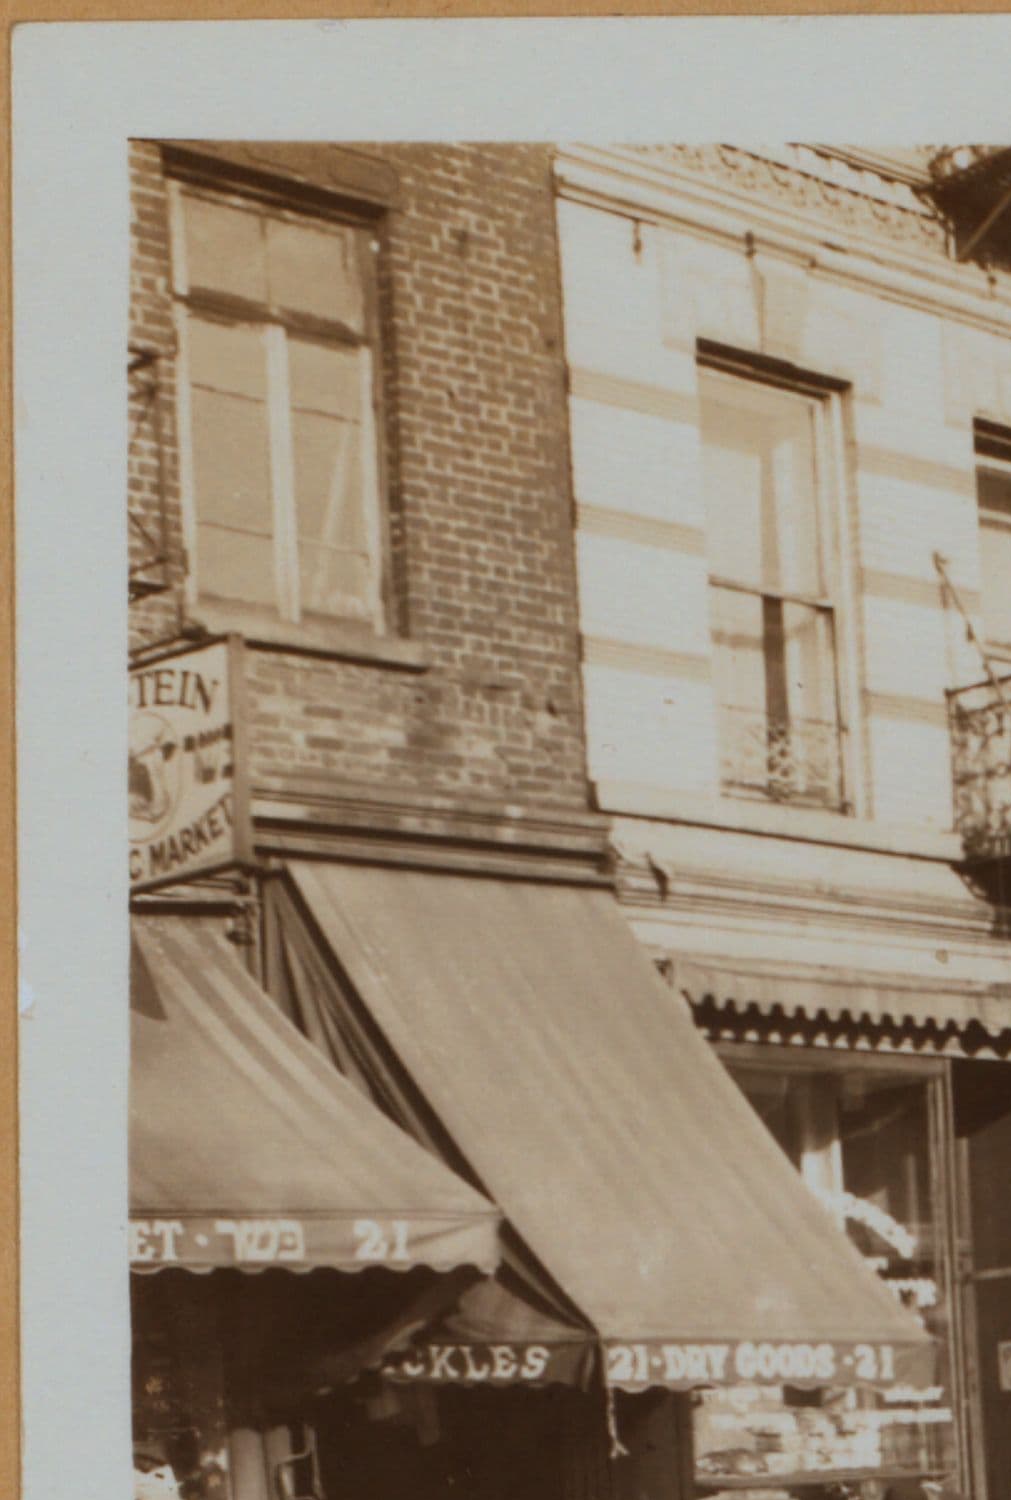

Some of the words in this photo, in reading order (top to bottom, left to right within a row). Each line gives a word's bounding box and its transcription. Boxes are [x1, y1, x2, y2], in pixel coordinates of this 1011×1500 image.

[148, 793, 235, 876] MARKET
[352, 1219, 411, 1261] 21
[381, 1344, 551, 1380] KLES
[607, 1344, 648, 1381] 21
[662, 1344, 729, 1380] DRY
[735, 1341, 836, 1380] GOODS
[854, 1344, 896, 1380] 21
